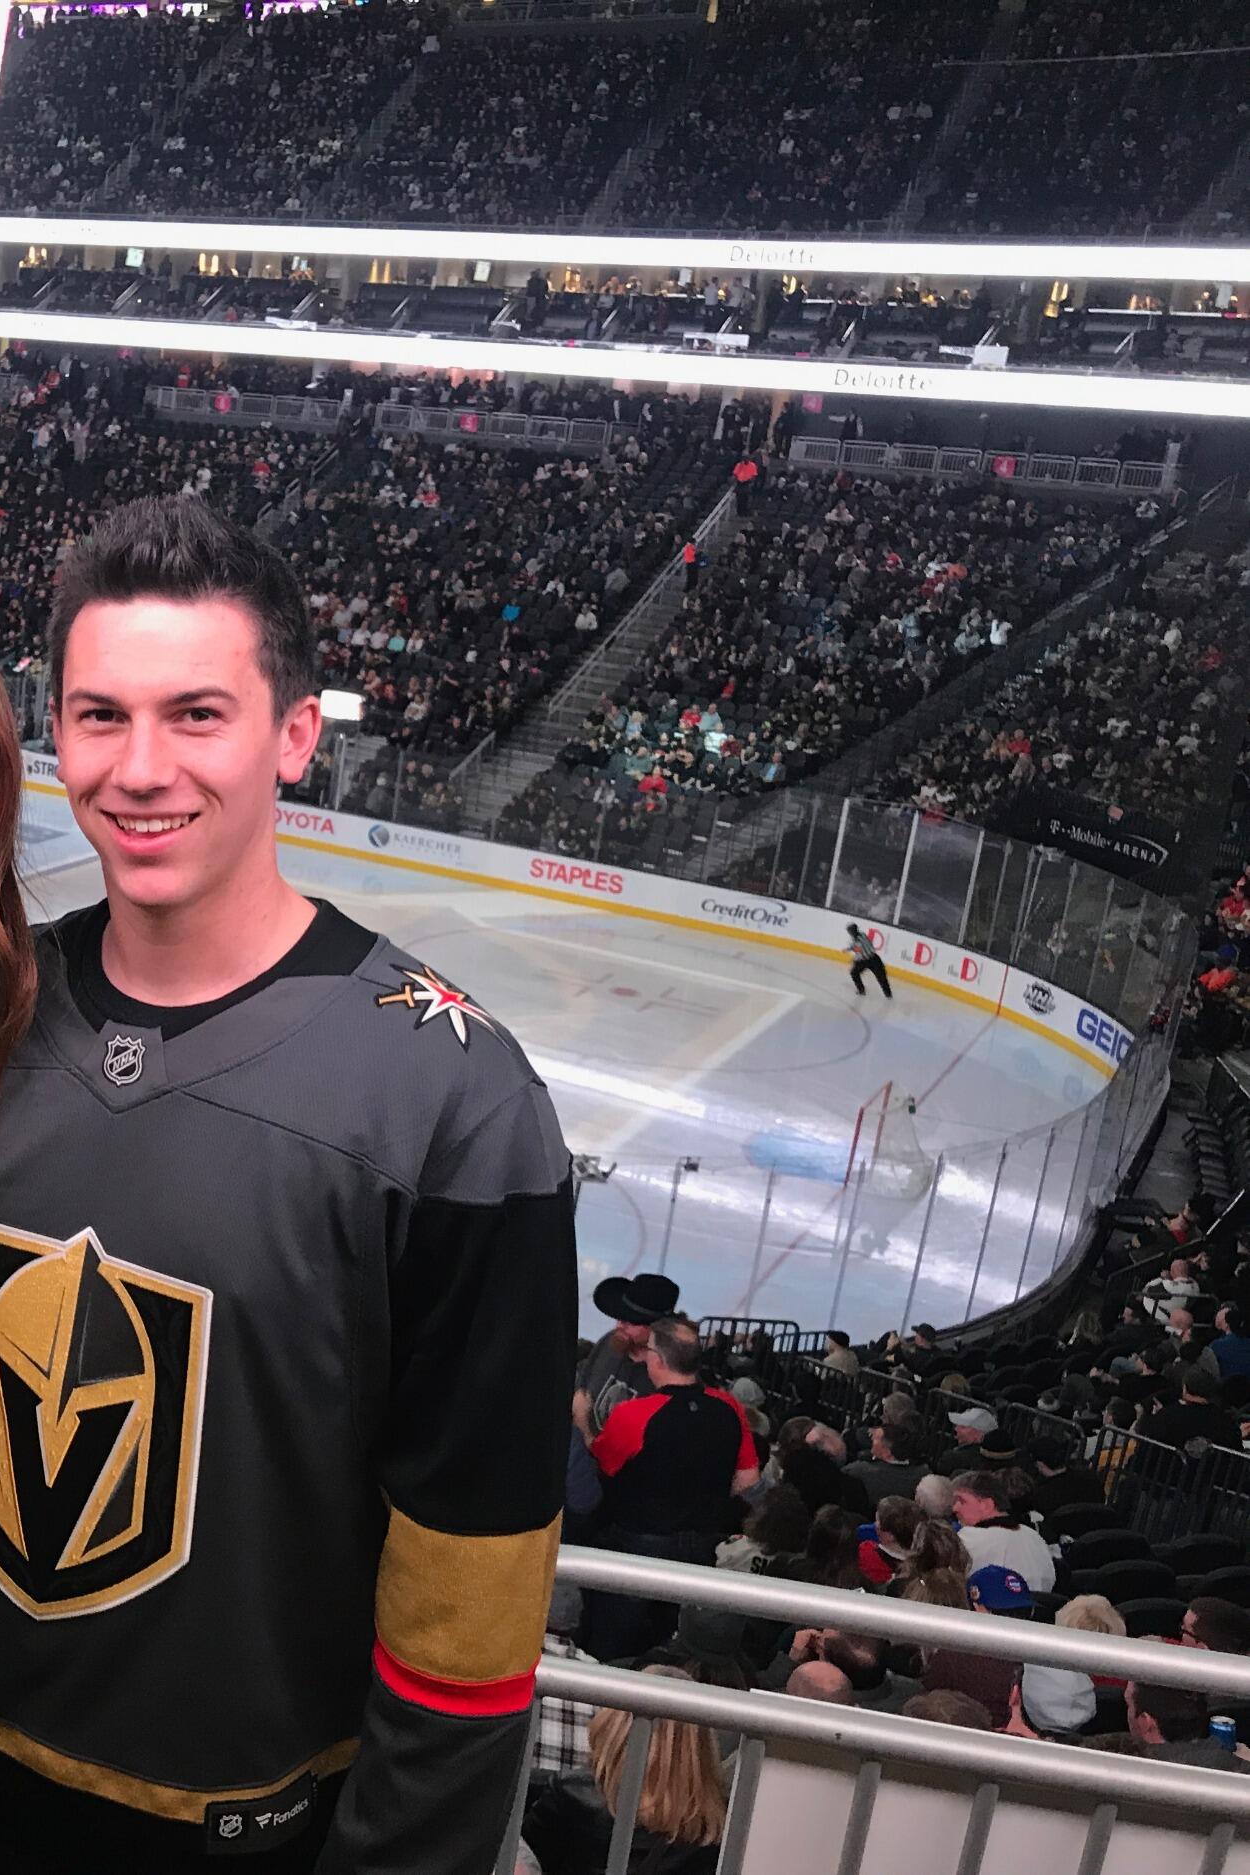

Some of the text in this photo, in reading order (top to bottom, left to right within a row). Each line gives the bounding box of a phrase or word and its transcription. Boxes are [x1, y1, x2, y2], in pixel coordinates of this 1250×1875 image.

[276, 808, 335, 835] YOTA
[1113, 841, 1157, 864] ARENA
[530, 858, 624, 895] STAPLES
[1076, 1008, 1135, 1064] GEIC
[112, 1052, 136, 1071] NHL
[273, 1798, 309, 1826] Fanatics
